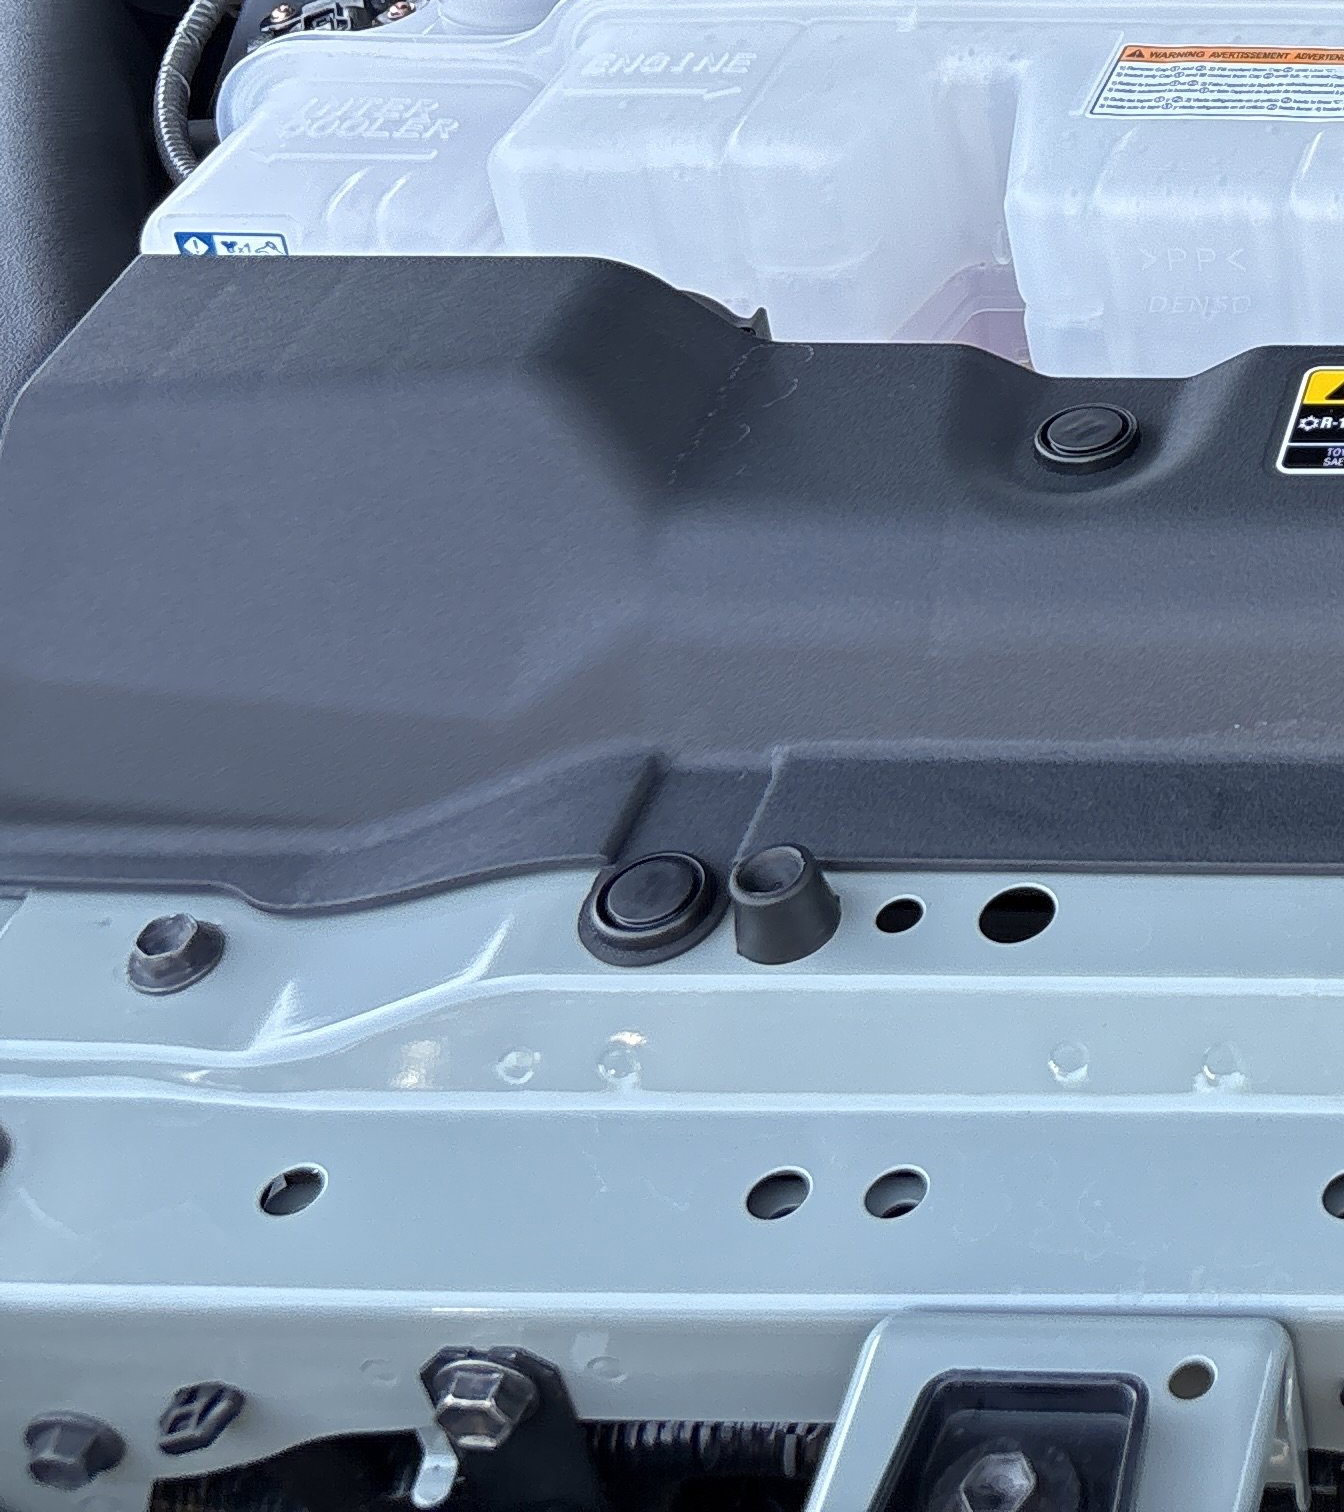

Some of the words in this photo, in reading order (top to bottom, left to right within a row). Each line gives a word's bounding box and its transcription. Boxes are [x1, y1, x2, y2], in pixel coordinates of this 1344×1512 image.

[1150, 50, 1205, 60] WARNING
[1209, 51, 1289, 61] AVERTISSEMENT
[579, 51, 758, 76] ENGINE
[1322, 457, 1344, 467] SAE
